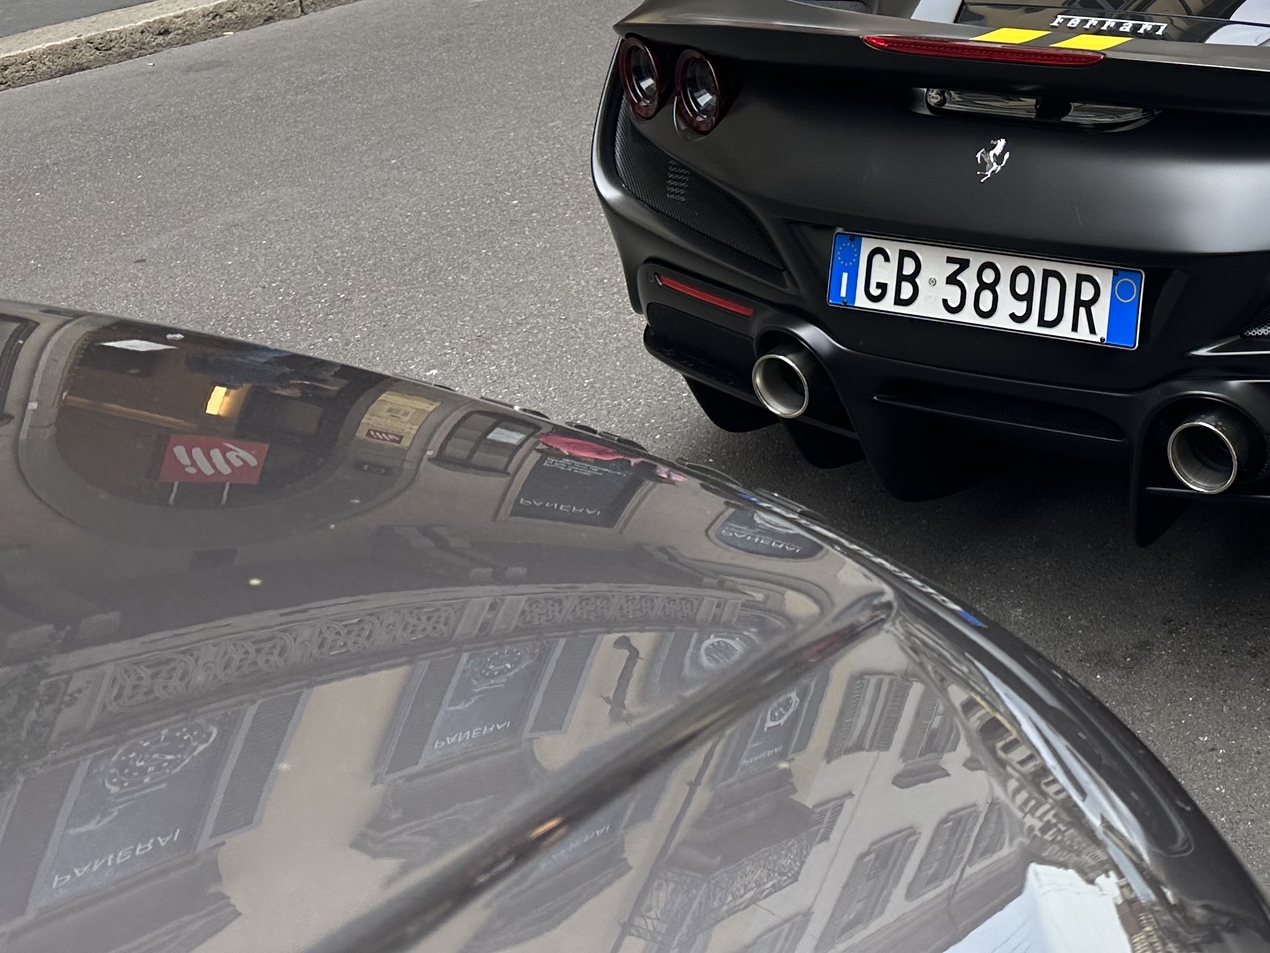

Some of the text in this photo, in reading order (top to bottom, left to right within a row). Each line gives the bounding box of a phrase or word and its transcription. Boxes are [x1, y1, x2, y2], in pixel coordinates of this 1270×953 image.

[1050, 14, 1168, 36] Ferrari
[864, 246, 923, 307] GB
[942, 255, 1101, 336] 389DR
